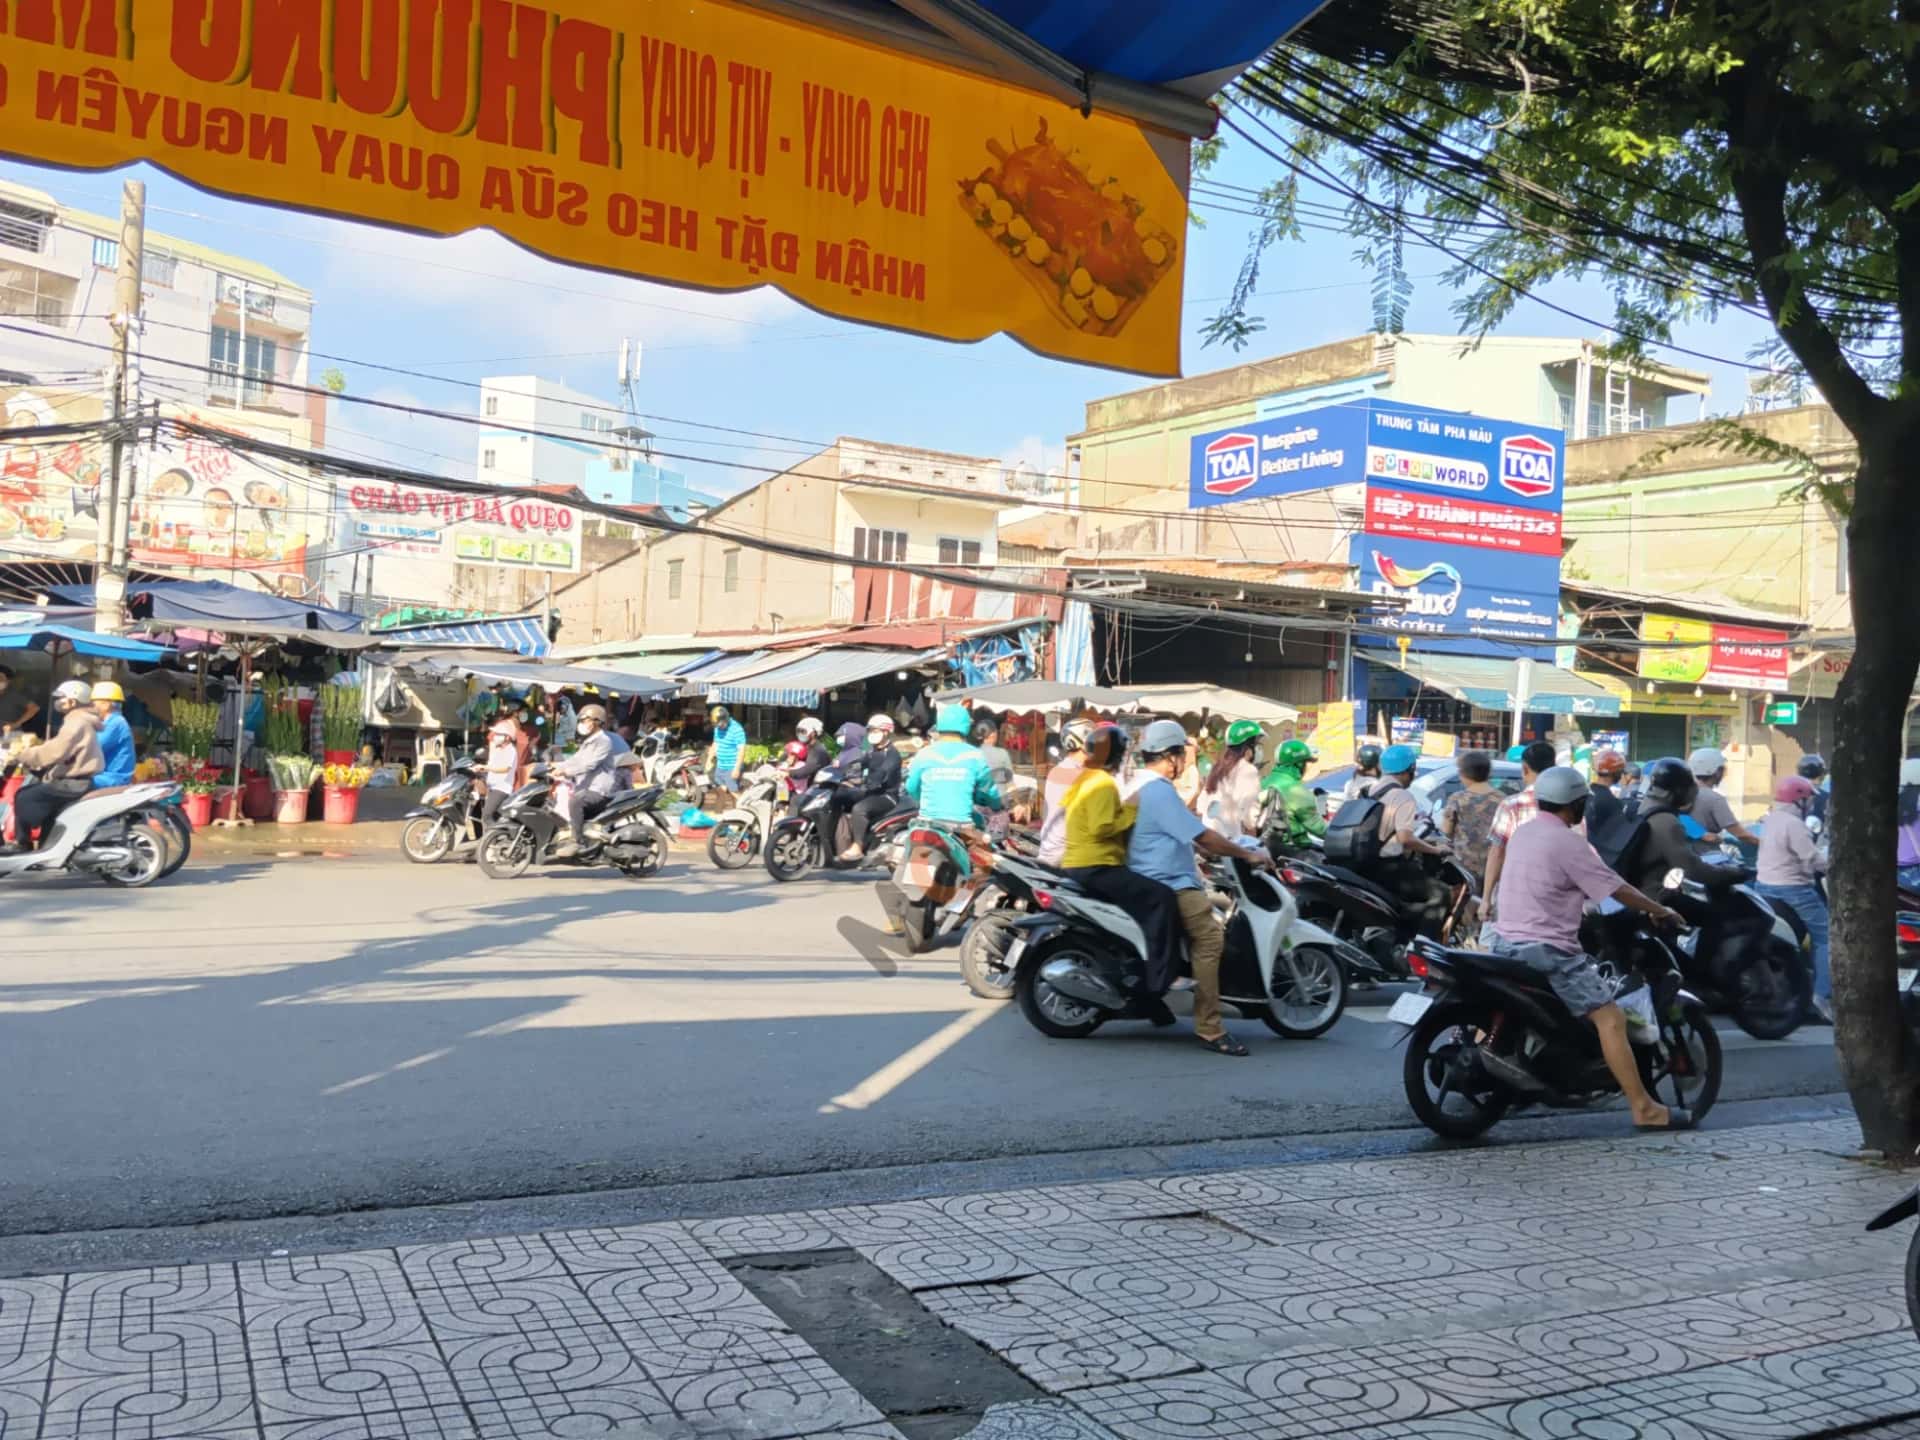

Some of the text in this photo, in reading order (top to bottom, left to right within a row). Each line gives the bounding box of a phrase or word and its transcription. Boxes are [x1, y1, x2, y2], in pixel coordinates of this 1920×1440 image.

[1262, 426, 1319, 450] Inspire
[1375, 413, 1493, 444] TRUNG TÂM PHA MÀU
[1208, 450, 1252, 480] TOA
[1261, 448, 1344, 477] Better Living
[1373, 453, 1487, 487] COLOR WORLD
[1505, 450, 1551, 482] TOA
